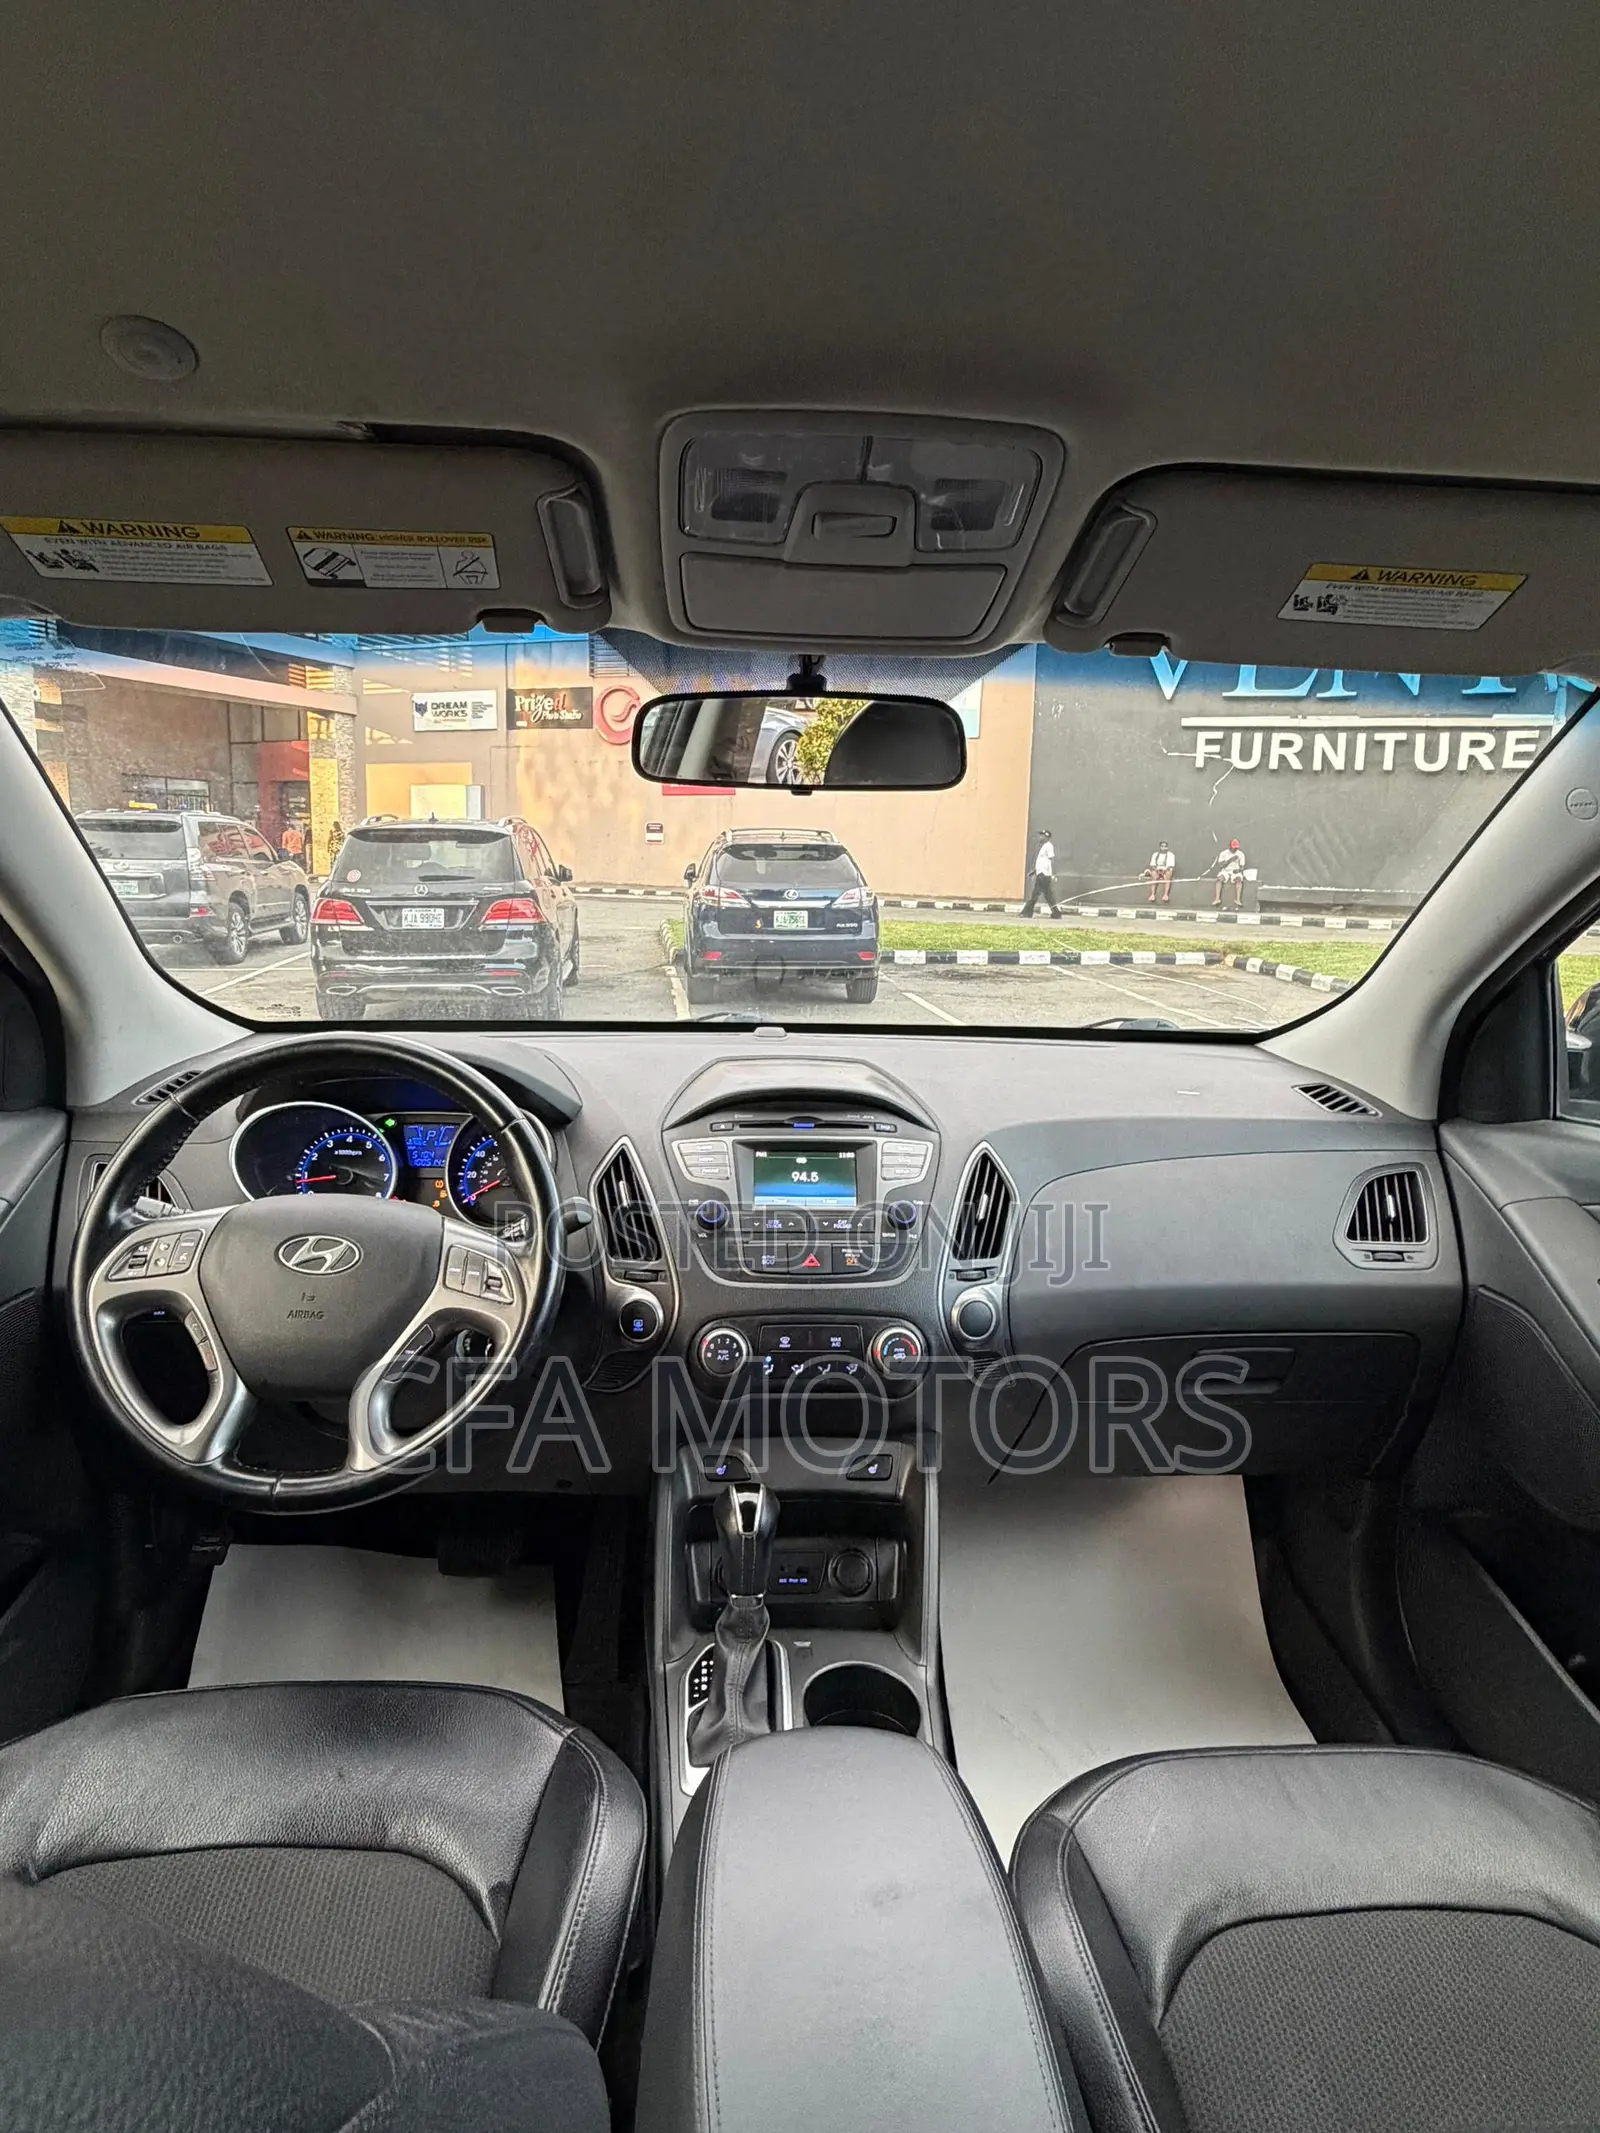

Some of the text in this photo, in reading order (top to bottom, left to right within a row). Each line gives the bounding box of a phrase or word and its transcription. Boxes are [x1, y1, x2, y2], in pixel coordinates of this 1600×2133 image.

[80, 522, 200, 539] WARNING
[44, 537, 76, 545] EVEN
[1377, 570, 1479, 586] WARNING
[431, 701, 468, 710] DREAM
[431, 710, 468, 718] WORKS
[1195, 729, 1541, 772] FURNITURE
[346, 1135, 353, 1143] 4
[427, 1130, 437, 1140] P
[326, 1139, 334, 1148] 3
[365, 1141, 373, 1149] 5
[311, 1152, 319, 1161] 2
[474, 1150, 486, 1158] 40
[383, 1173, 390, 1182] 7
[466, 1171, 477, 1179] 20
[791, 1171, 819, 1183] 94.5
[287, 1309, 325, 1320] AIRBAG
